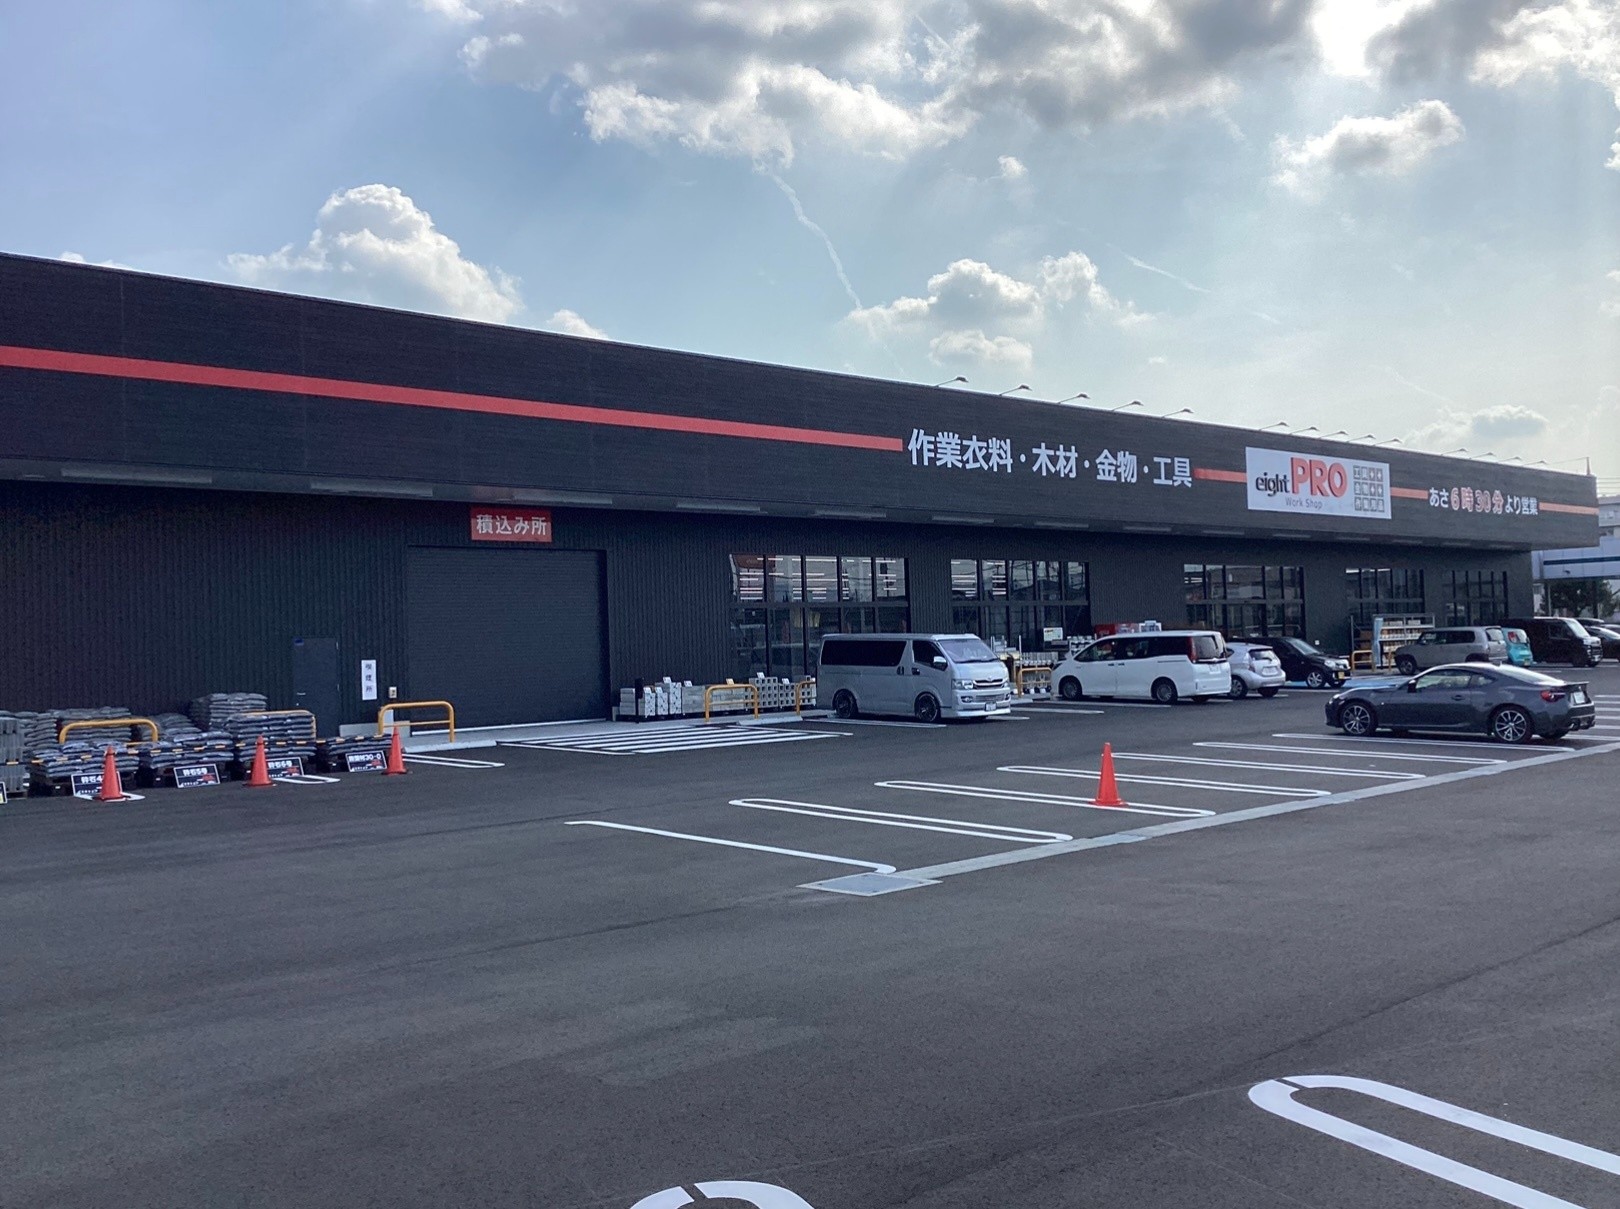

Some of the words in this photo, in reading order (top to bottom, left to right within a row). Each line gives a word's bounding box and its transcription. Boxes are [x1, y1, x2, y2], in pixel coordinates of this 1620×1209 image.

[1256, 472, 1290, 496] eight
[1291, 457, 1347, 497] PRO
[476, 514, 547, 536] 積込み所
